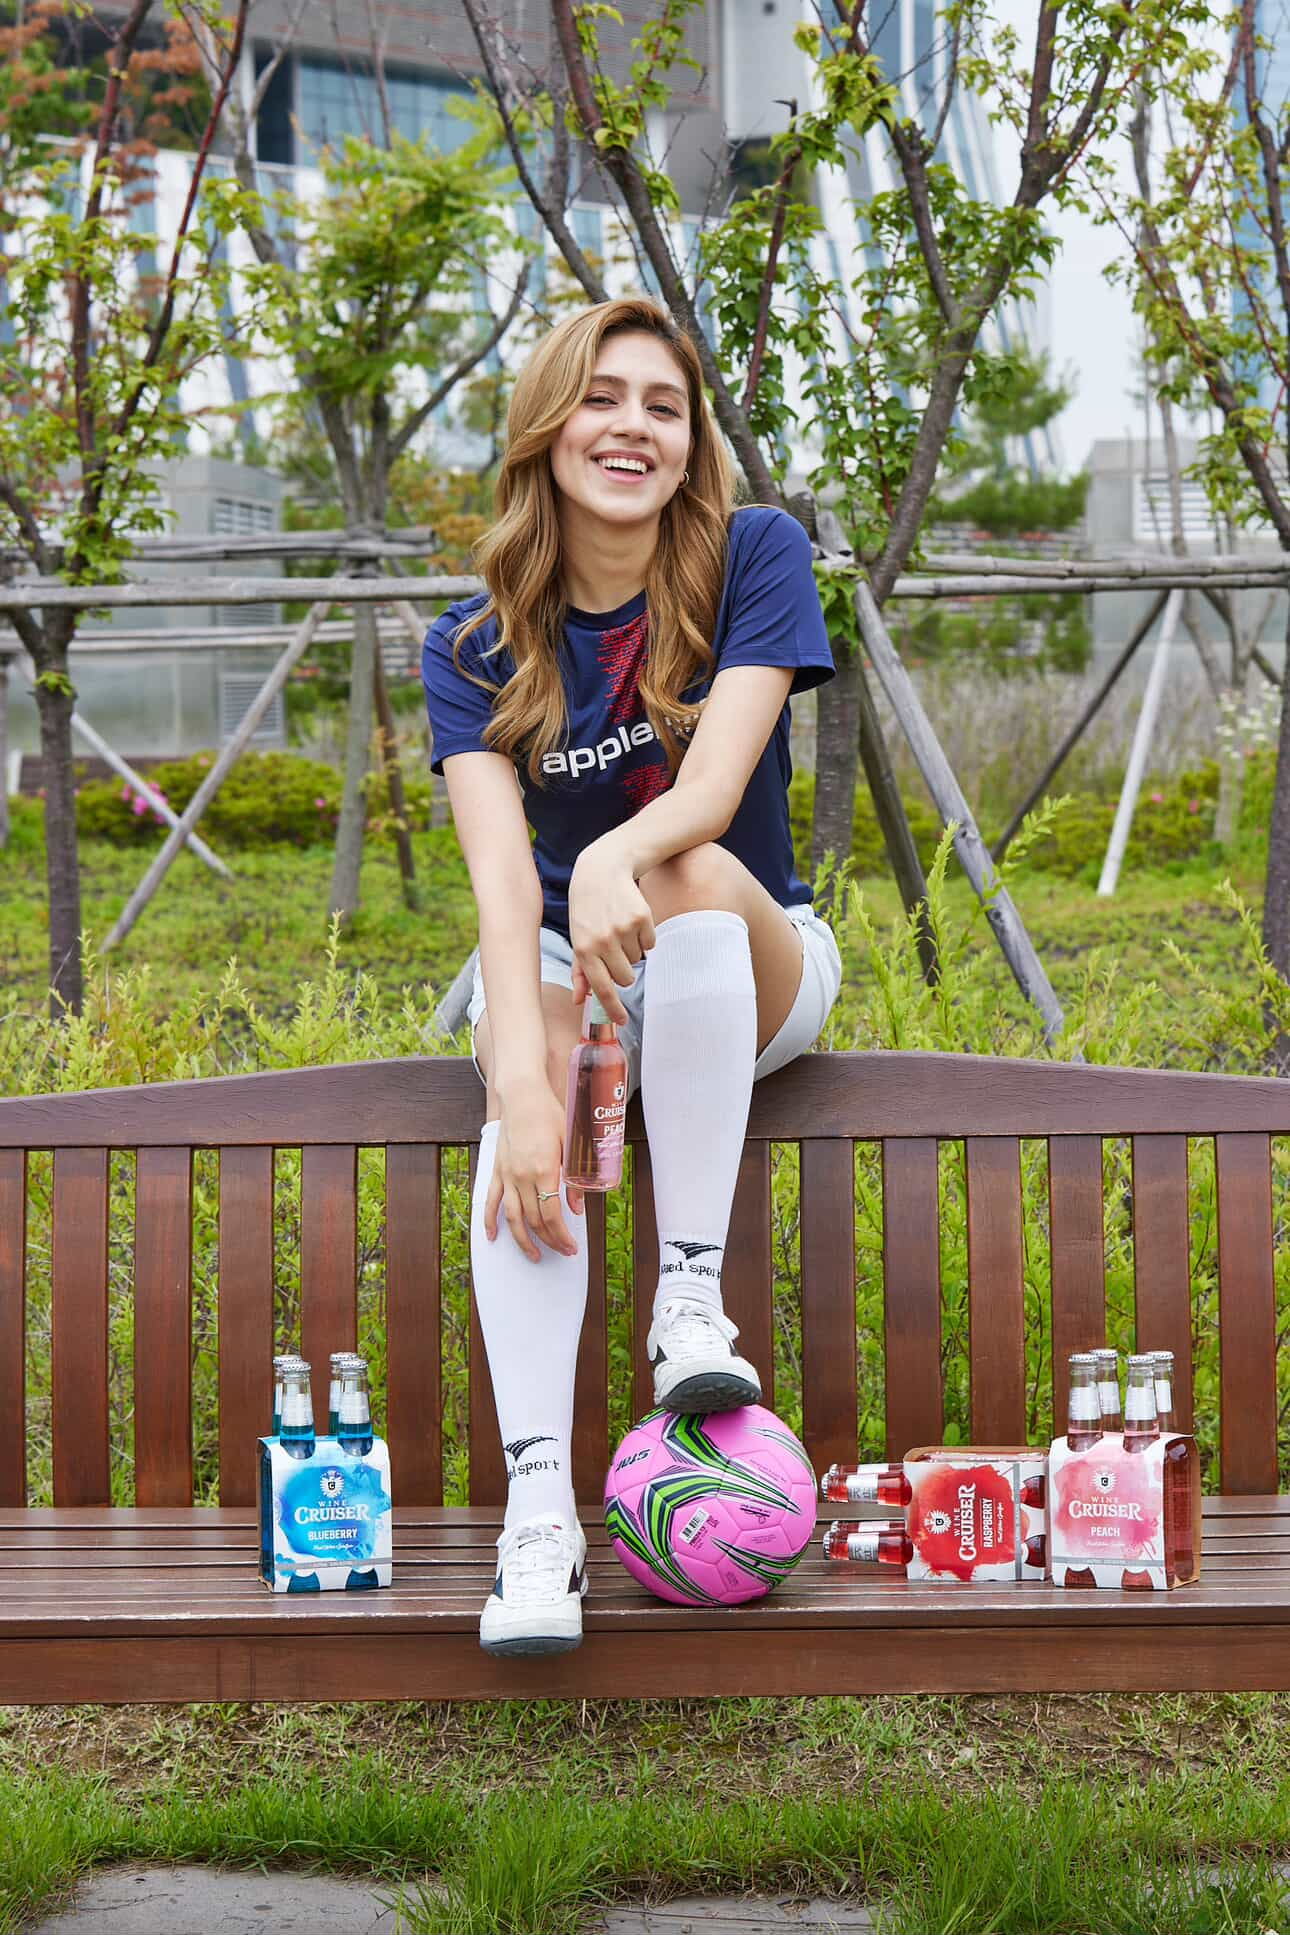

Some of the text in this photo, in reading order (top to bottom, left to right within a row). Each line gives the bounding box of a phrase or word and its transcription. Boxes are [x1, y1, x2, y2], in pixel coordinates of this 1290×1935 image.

[542, 721, 660, 778] apple
[518, 1459, 560, 1475] sport
[294, 1503, 371, 1524] CRUISER
[1068, 1500, 1144, 1520] CRUISER
[958, 1483, 977, 1561] CRUISER
[982, 1498, 993, 1548] RASPBERRY
[1090, 1526, 1121, 1537] PEACH
[308, 1528, 358, 1541] BLUEBERRY
